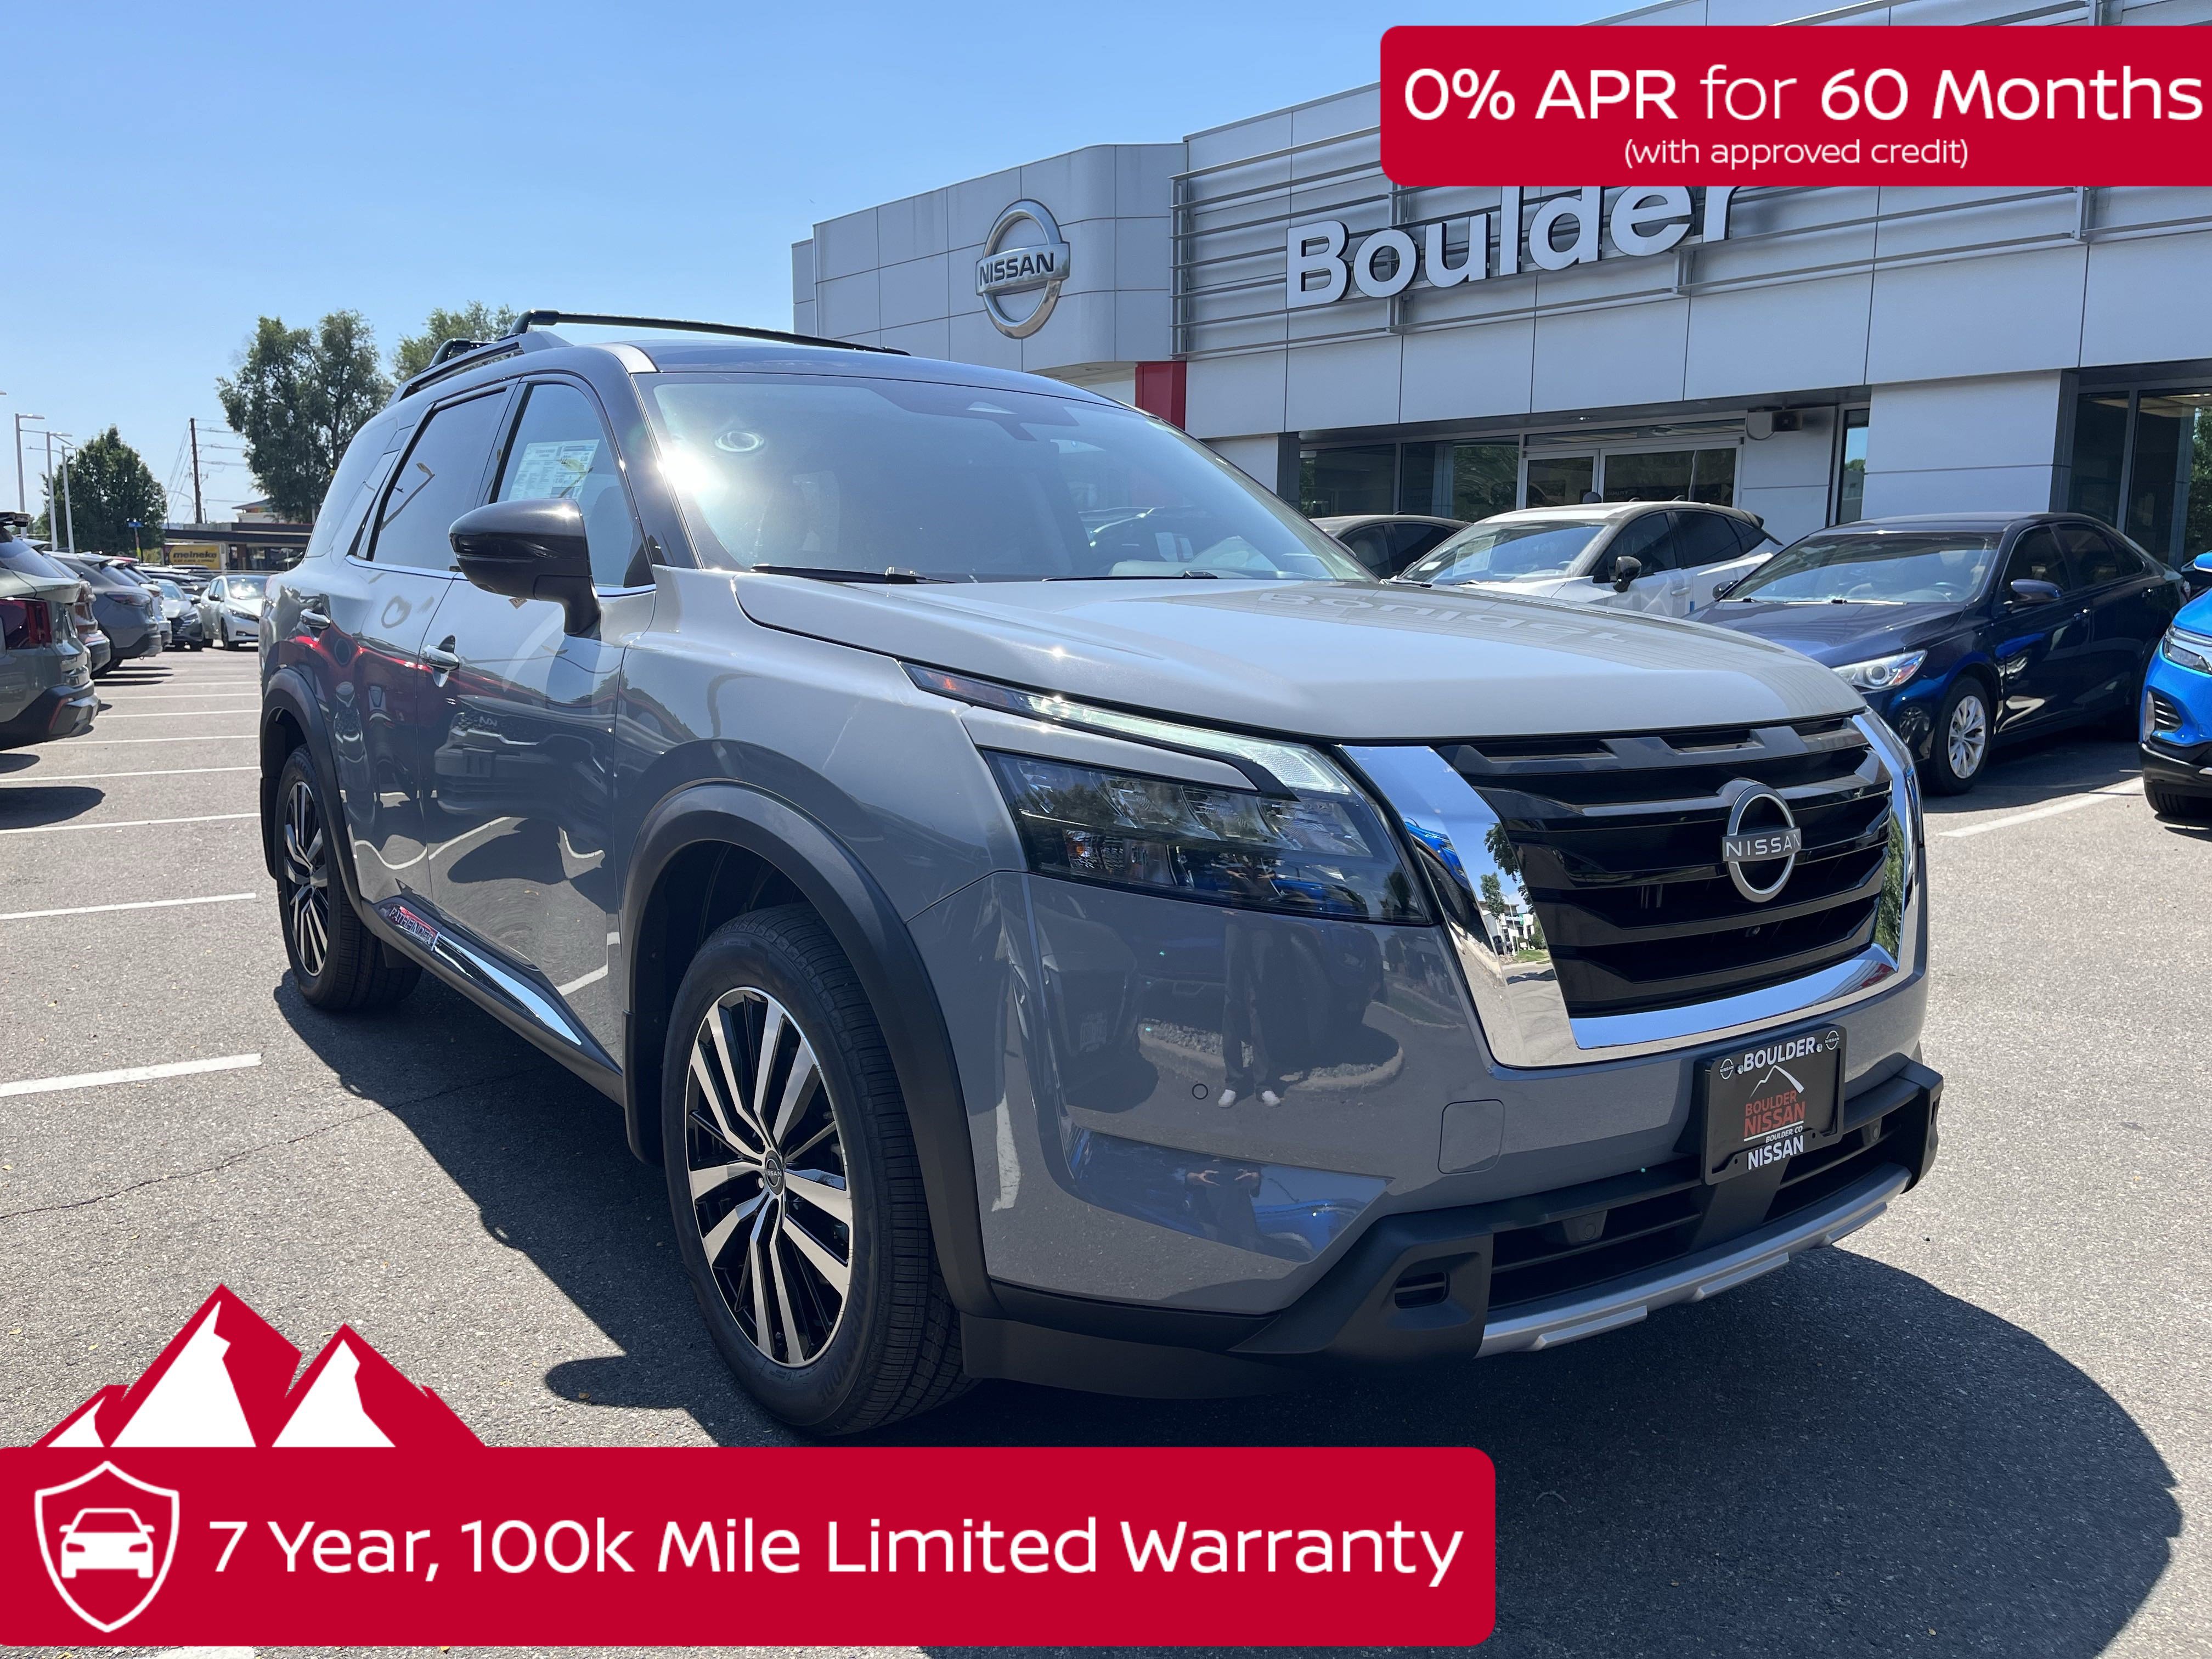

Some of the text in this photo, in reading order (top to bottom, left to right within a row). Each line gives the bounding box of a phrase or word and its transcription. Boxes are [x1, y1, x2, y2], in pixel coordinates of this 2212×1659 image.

[1286, 186, 1736, 309] Boulder
[979, 251, 1054, 286] NISSAN
[1726, 834, 1800, 857] NISSAN
[388, 907, 434, 945] PATHFINDER
[1743, 1036, 1815, 1072] BOULDER
[1743, 1101, 1805, 1137] NISSAN
[1745, 1090, 1797, 1116] BOULDER
[1795, 1125, 1803, 1133] CO
[1747, 1135, 1804, 1170] NISSAN
